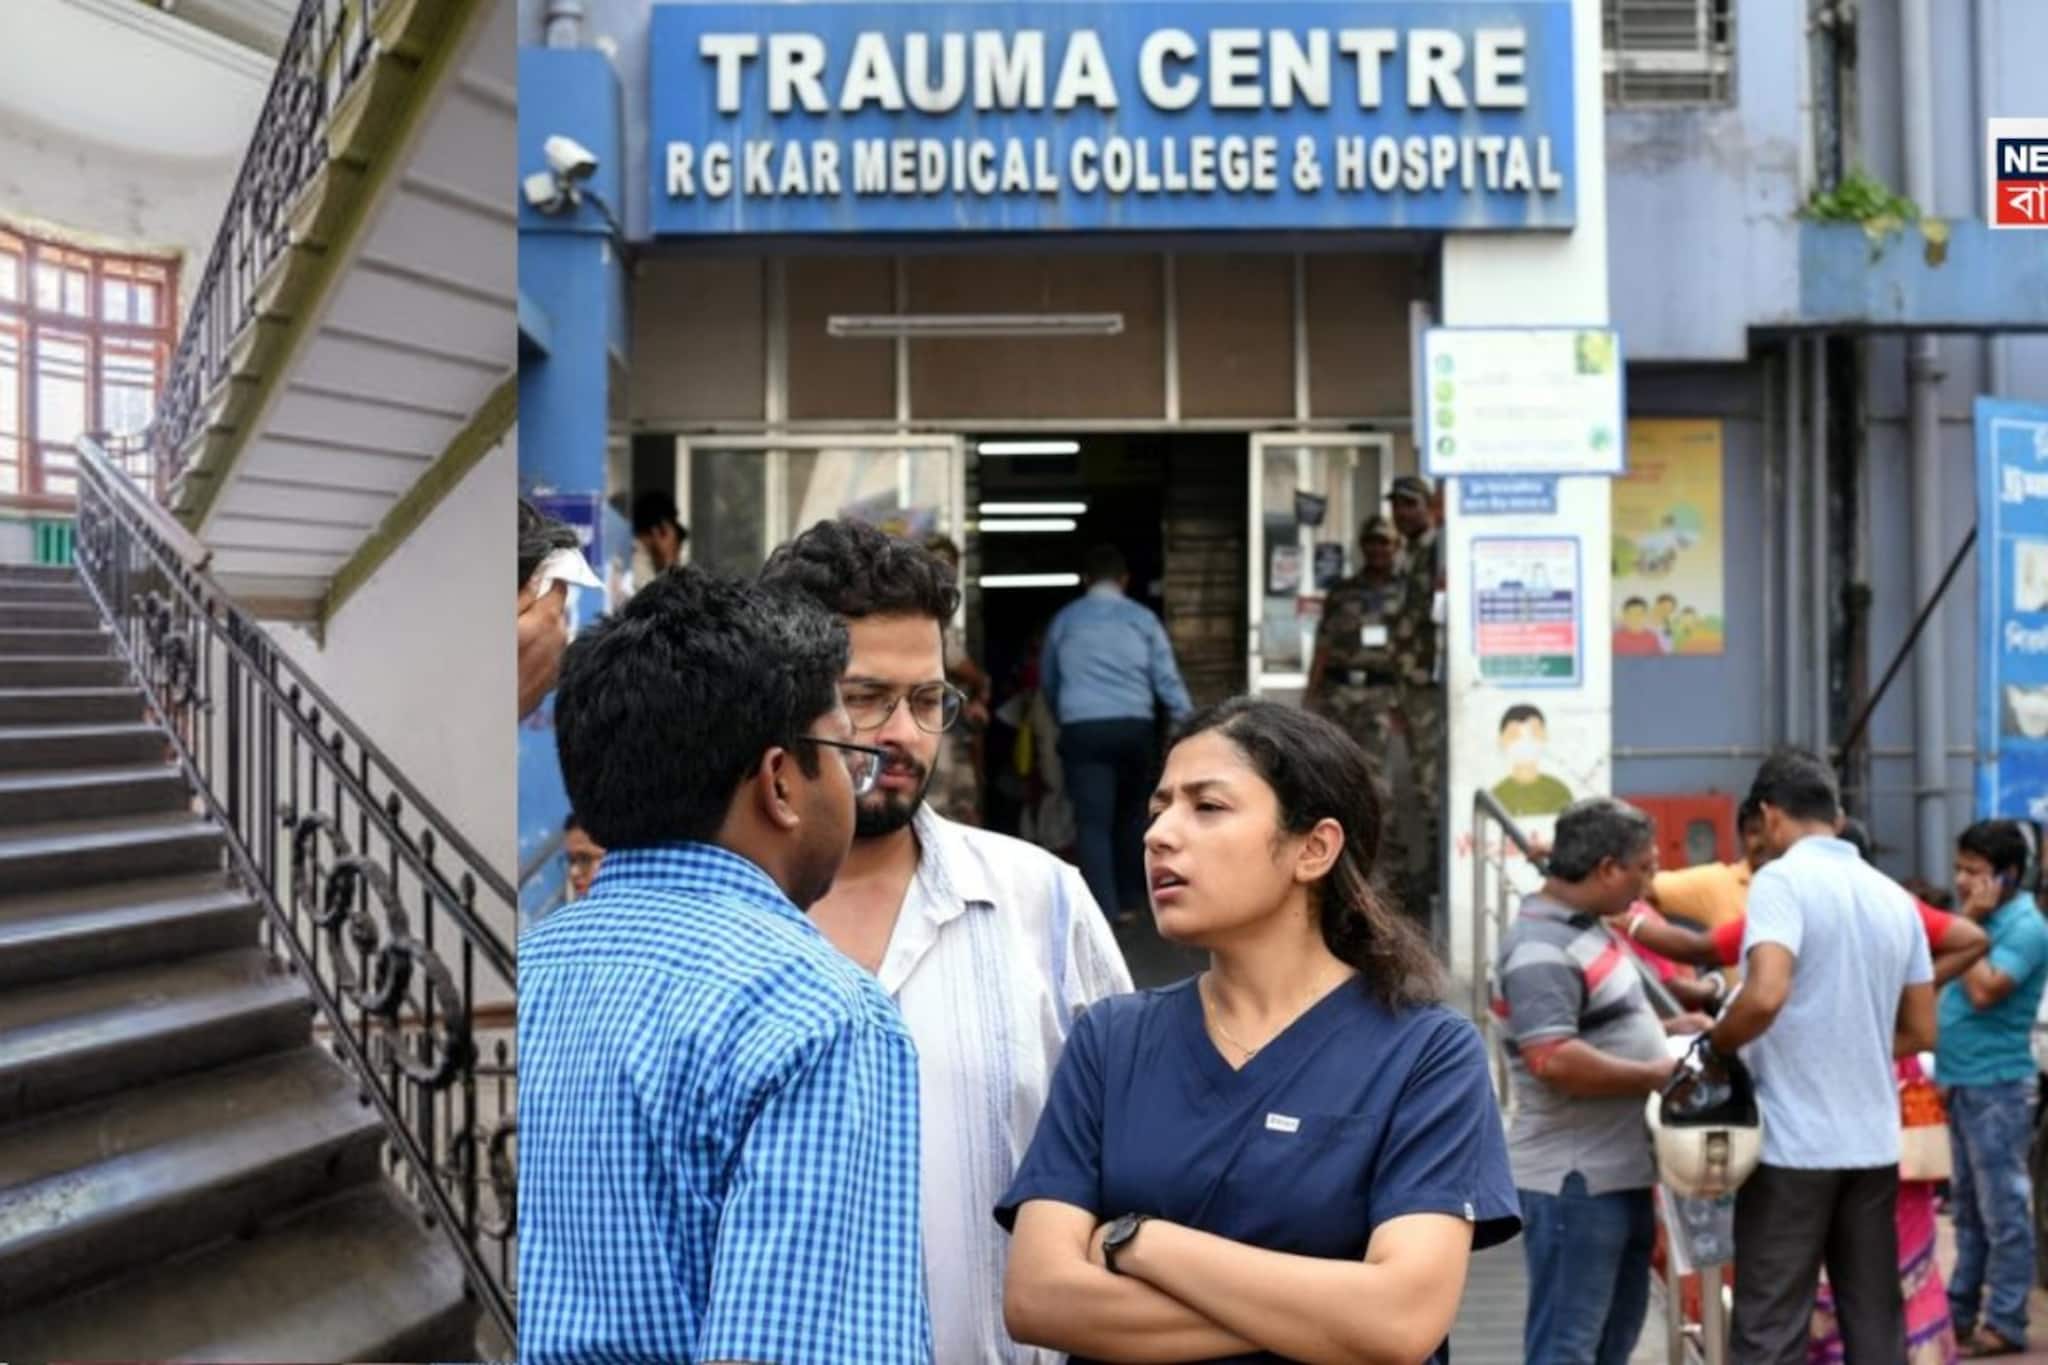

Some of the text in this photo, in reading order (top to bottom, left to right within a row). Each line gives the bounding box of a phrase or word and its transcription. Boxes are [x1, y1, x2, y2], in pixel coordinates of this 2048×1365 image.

[700, 27, 1529, 111] TRAUMA CENTRE
[744, 139, 841, 193] KAR
[853, 138, 1059, 192] MEDICAL
[1070, 136, 1277, 192] COLLEGE
[1293, 135, 1323, 190] &
[1337, 135, 1563, 190] HOSPITAL
